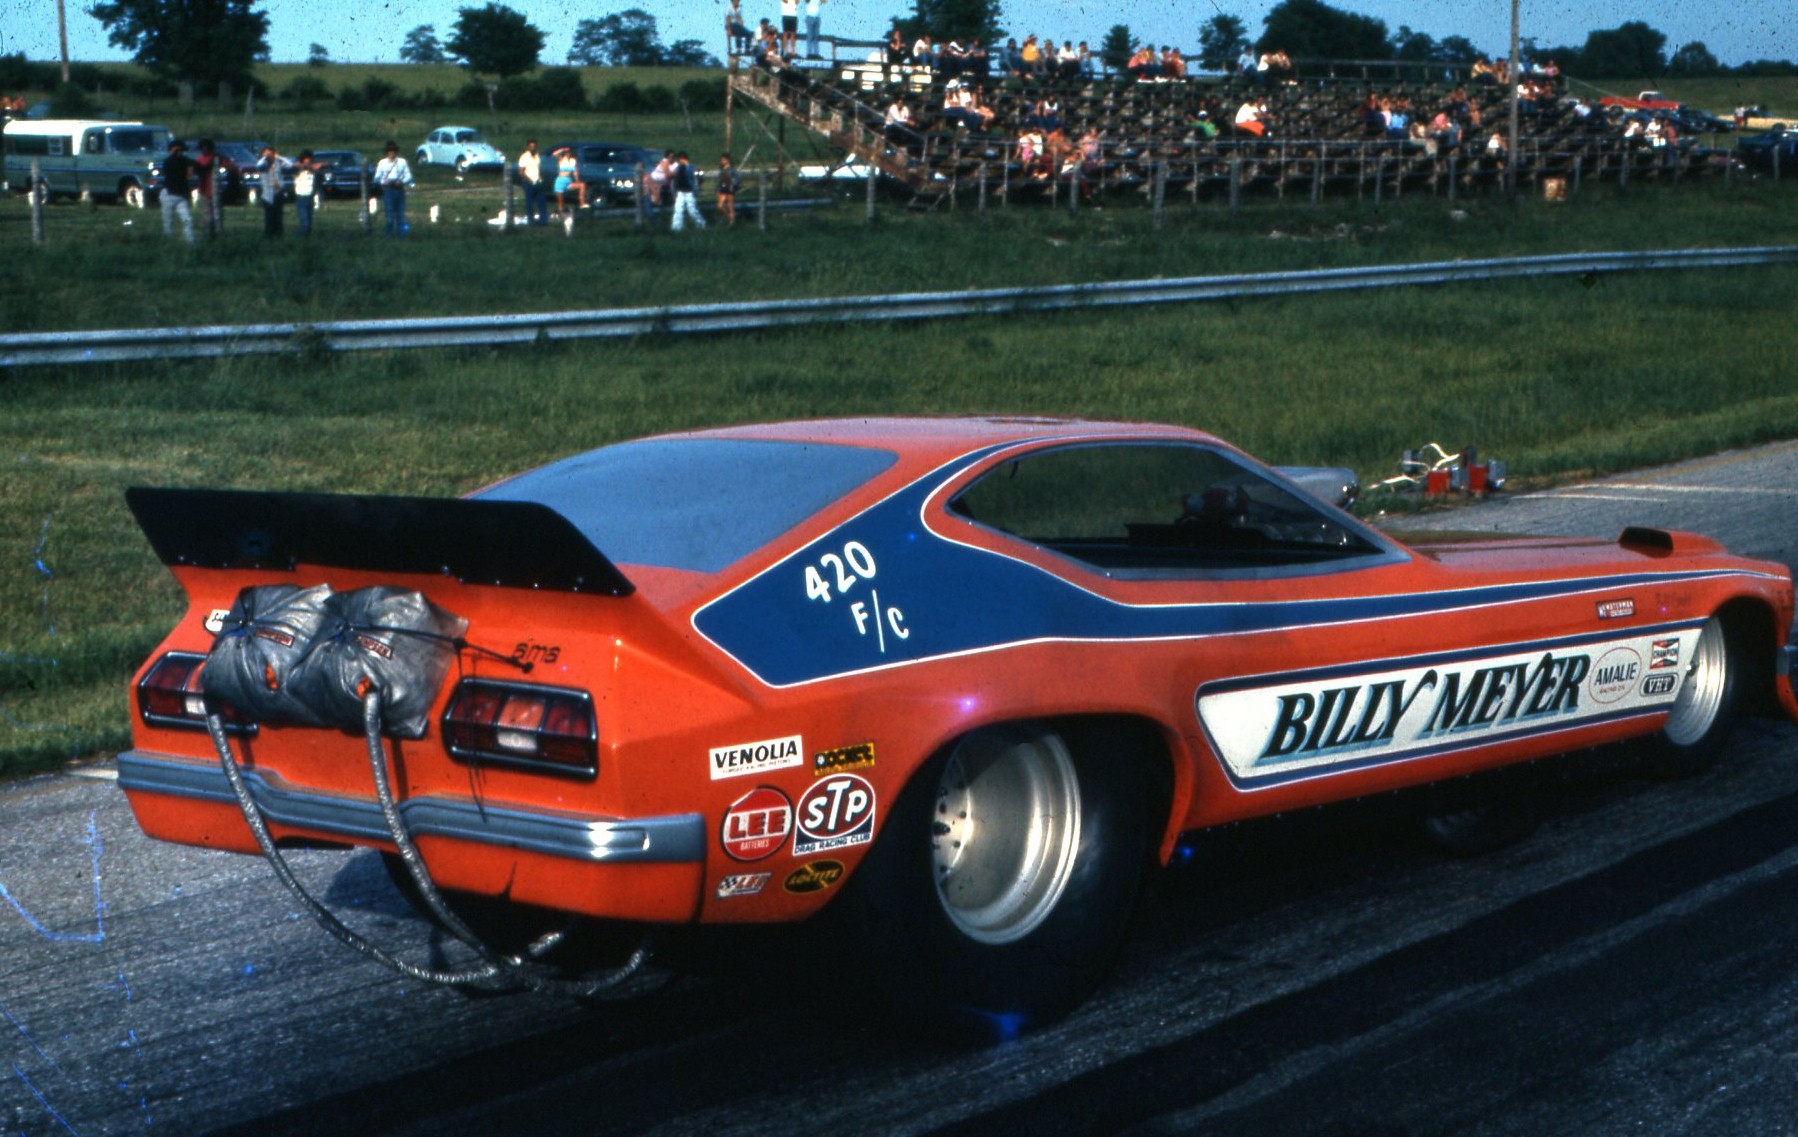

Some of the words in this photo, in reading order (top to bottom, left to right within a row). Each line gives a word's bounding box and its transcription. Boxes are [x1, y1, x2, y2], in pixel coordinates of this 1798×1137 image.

[804, 541, 876, 602] 420
[850, 589, 909, 653] F/C
[1594, 661, 1638, 686] AMALIE
[1648, 677, 1672, 693] VHT
[1252, 669, 1438, 765] BILLY
[1413, 651, 1591, 740] MEYER
[715, 740, 798, 769] VENOLIA
[804, 780, 868, 830] STP
[729, 809, 787, 839] LEE
[740, 839, 770, 851] BATTERIES
[795, 843, 816, 854] DRAG
[819, 836, 848, 849] RACING
[850, 832, 870, 843] CLUB
